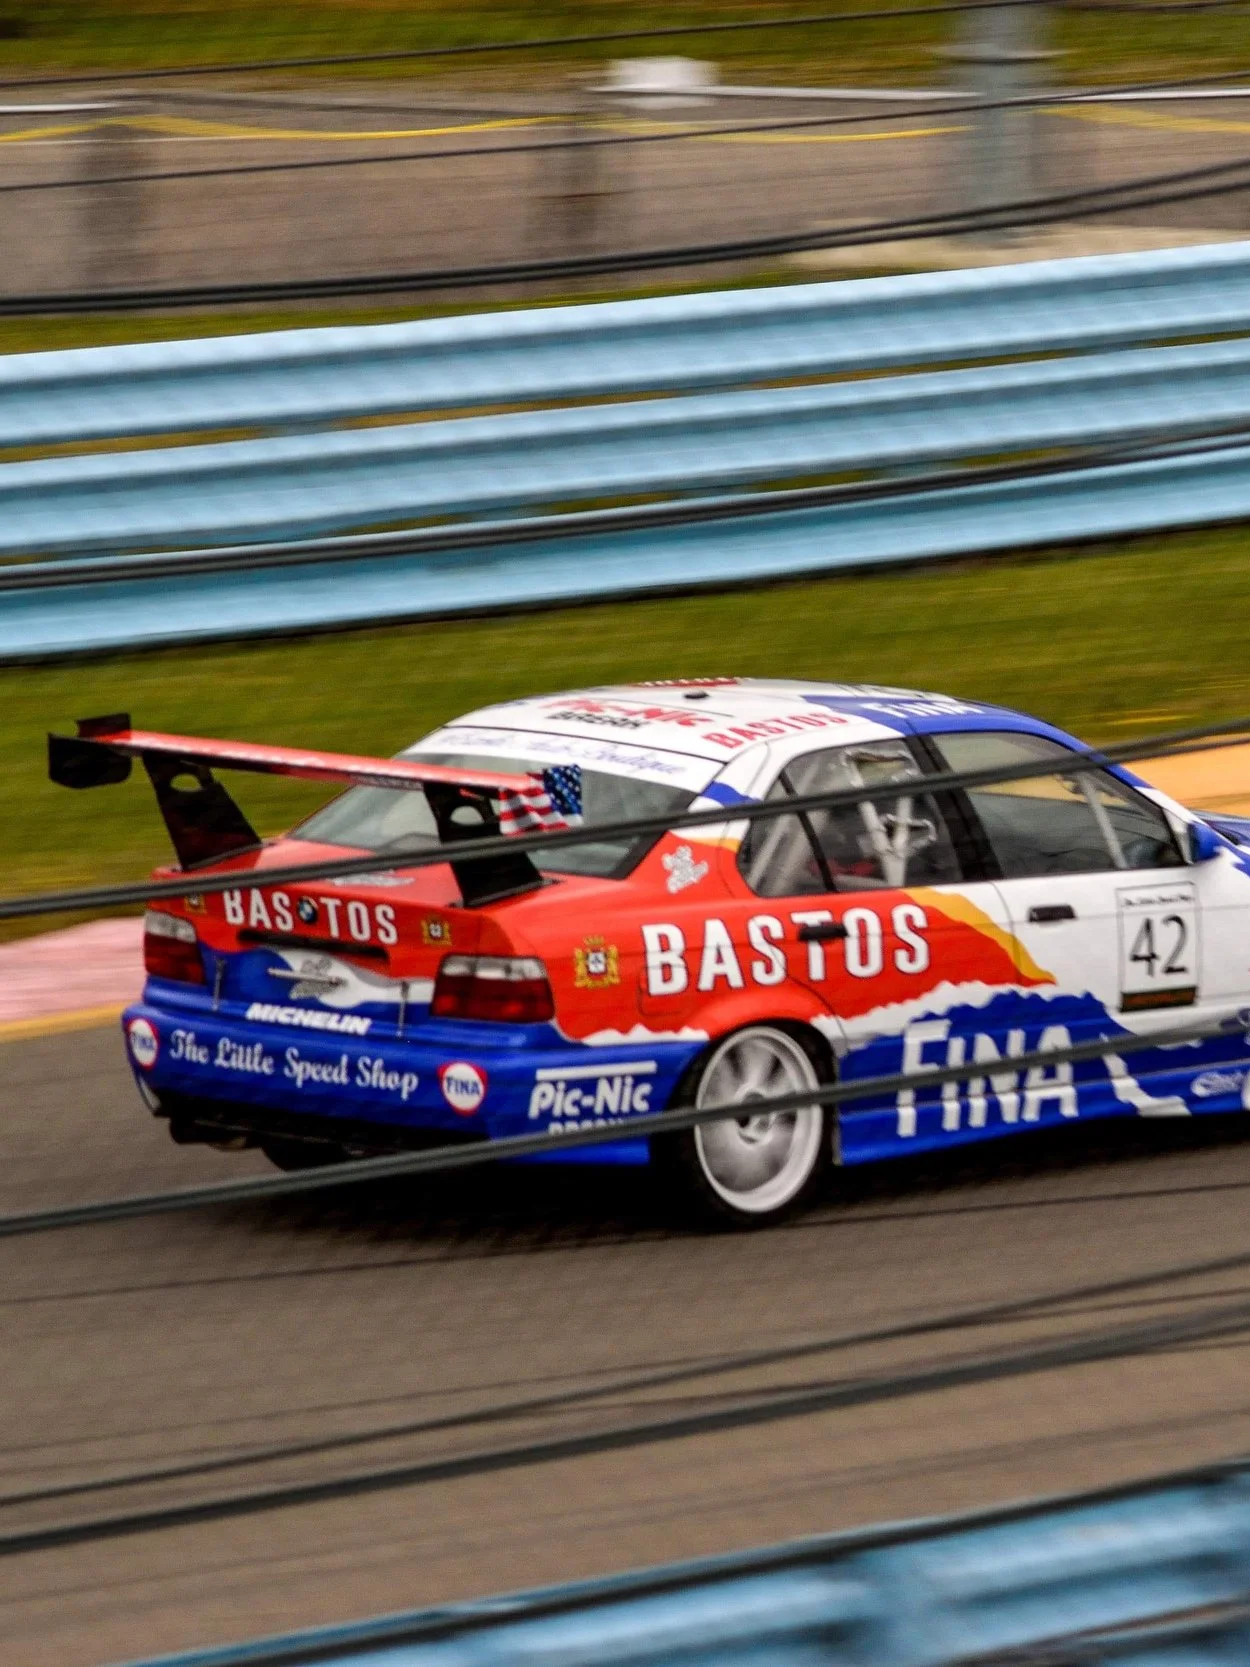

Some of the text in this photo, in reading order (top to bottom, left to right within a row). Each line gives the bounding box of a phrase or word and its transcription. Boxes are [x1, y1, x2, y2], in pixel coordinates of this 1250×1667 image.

[701, 712, 849, 749] BASTOS
[641, 903, 930, 997] BASTOS
[1129, 914, 1188, 978] 42
[244, 1002, 373, 1036] MICHELIN
[169, 1029, 419, 1101] The Little Speed Shop
[445, 1075, 482, 1097] FINA
[897, 1018, 1079, 1138] FINA
[527, 1074, 653, 1120] Pic-Nic
